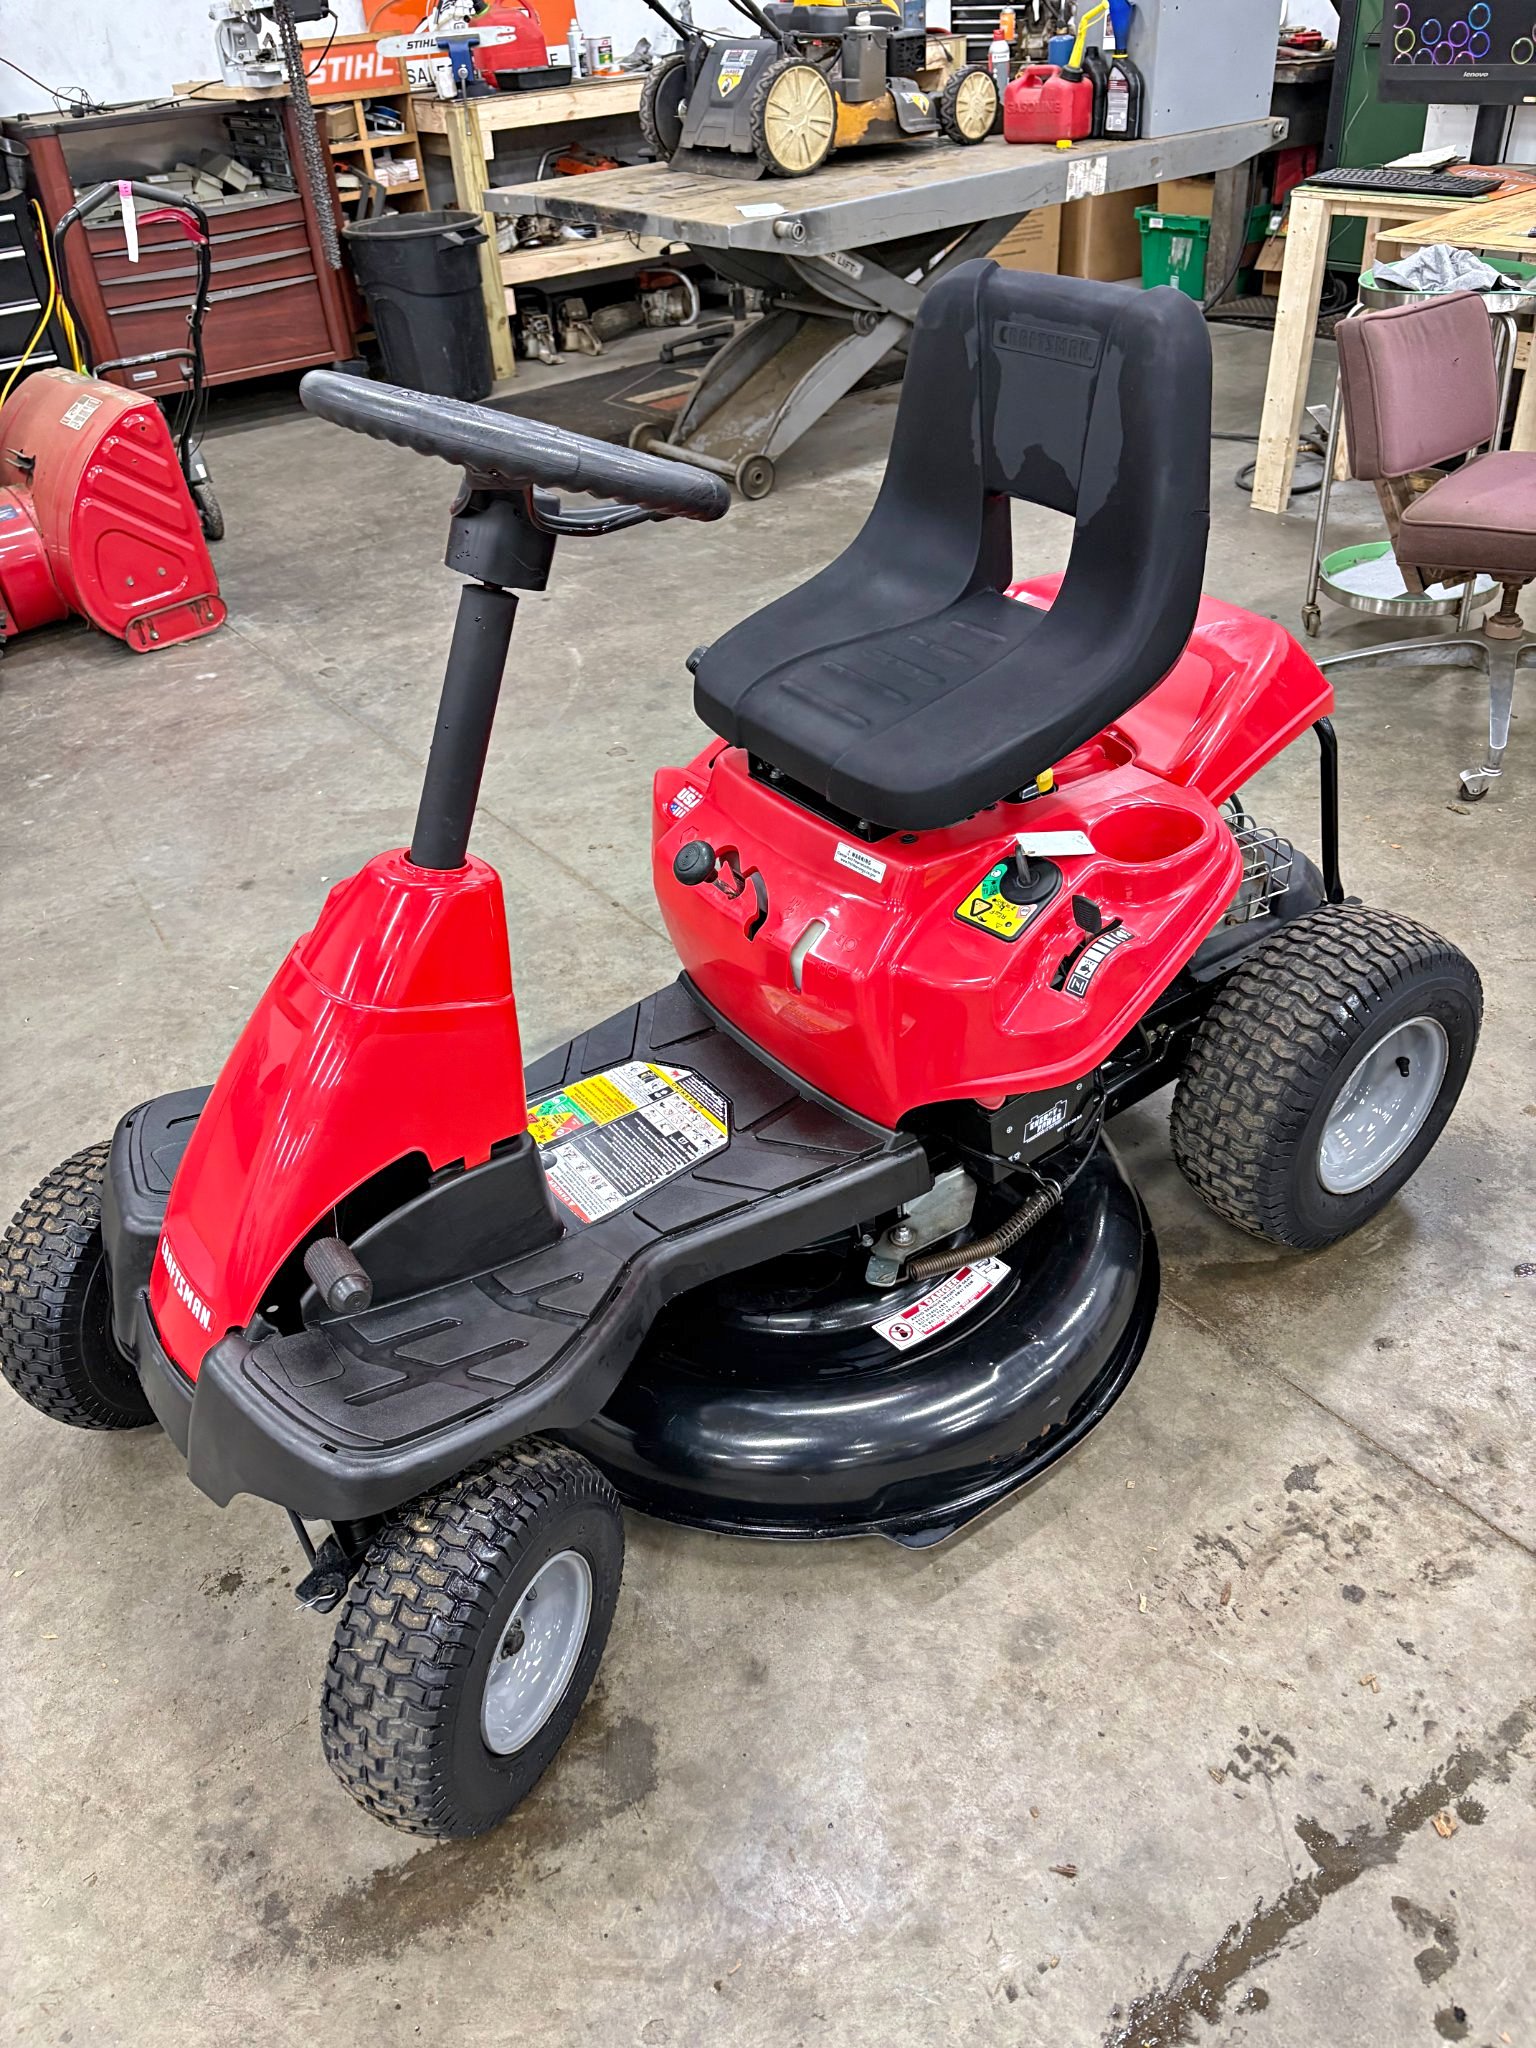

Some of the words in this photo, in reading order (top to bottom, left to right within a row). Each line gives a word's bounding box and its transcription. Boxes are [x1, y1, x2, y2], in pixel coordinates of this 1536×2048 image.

[406, 39, 437, 49] STIHL
[307, 53, 394, 86] STIHL
[1006, 100, 1061, 114] GASOLINE
[851, 852, 872, 865] WARNING
[548, 1178, 570, 1202] DANGER
[161, 1236, 212, 1332] CRAFTSMAN
[924, 1277, 960, 1306] DANGER
